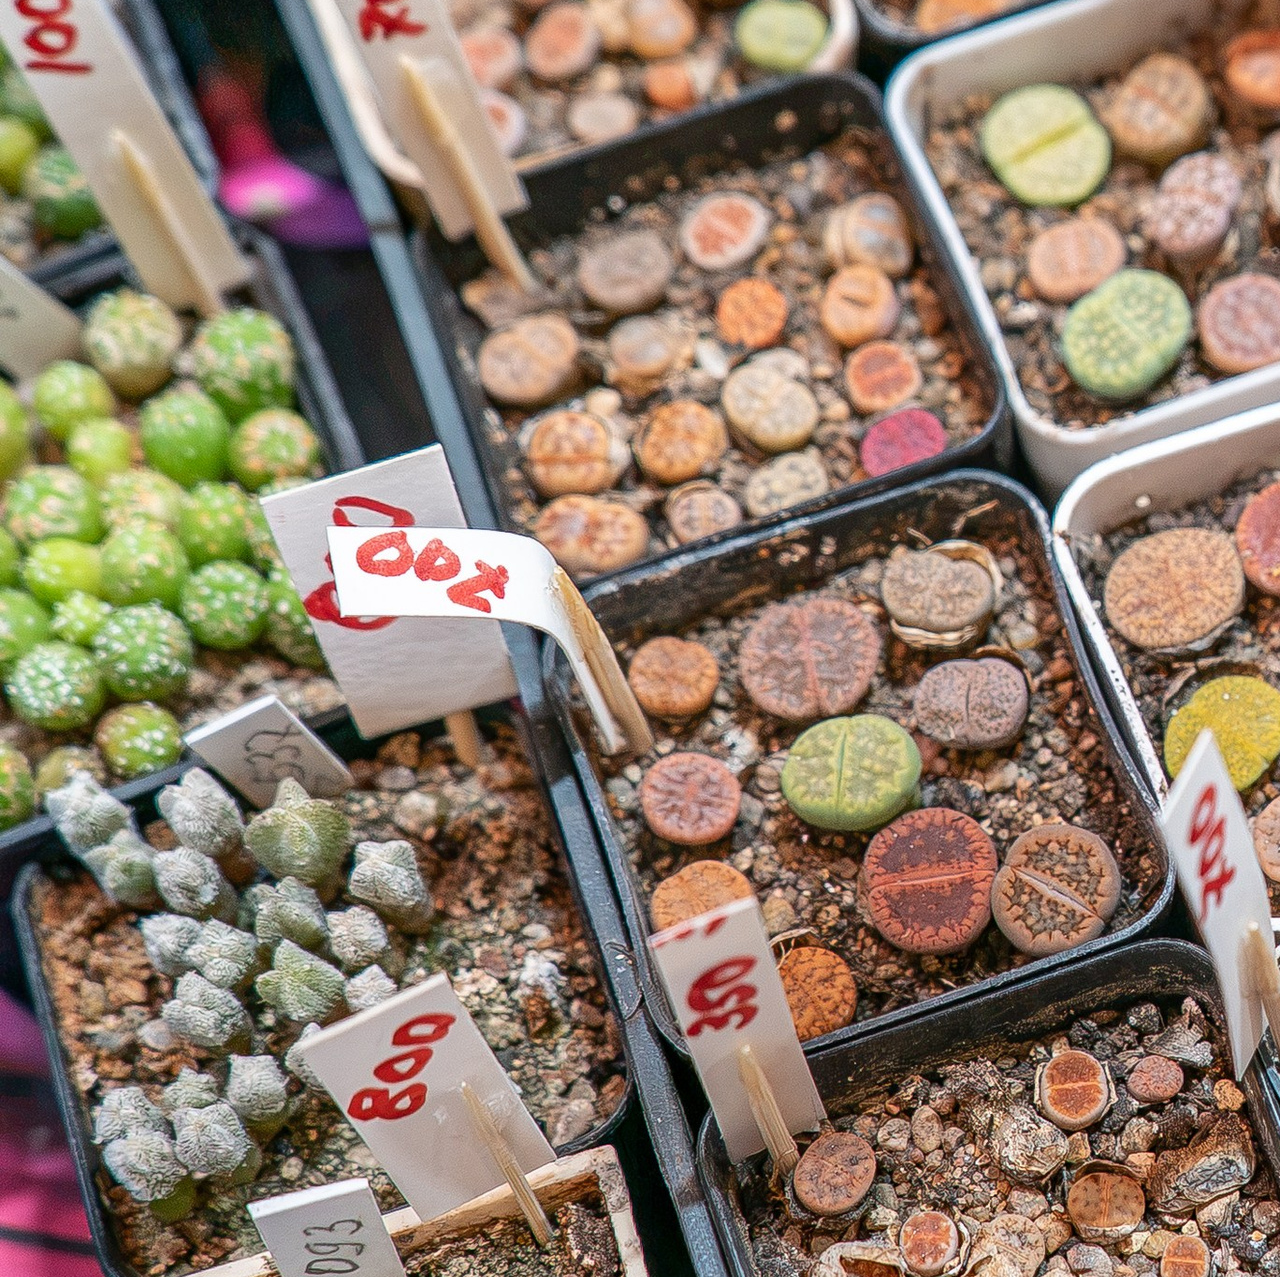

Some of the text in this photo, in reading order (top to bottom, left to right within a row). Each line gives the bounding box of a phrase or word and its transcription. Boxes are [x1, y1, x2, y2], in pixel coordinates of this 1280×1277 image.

[356, 531, 509, 614] 700
[1189, 785, 1235, 916] 700
[686, 956, 757, 1037] 350
[347, 1014, 454, 1121] 800
